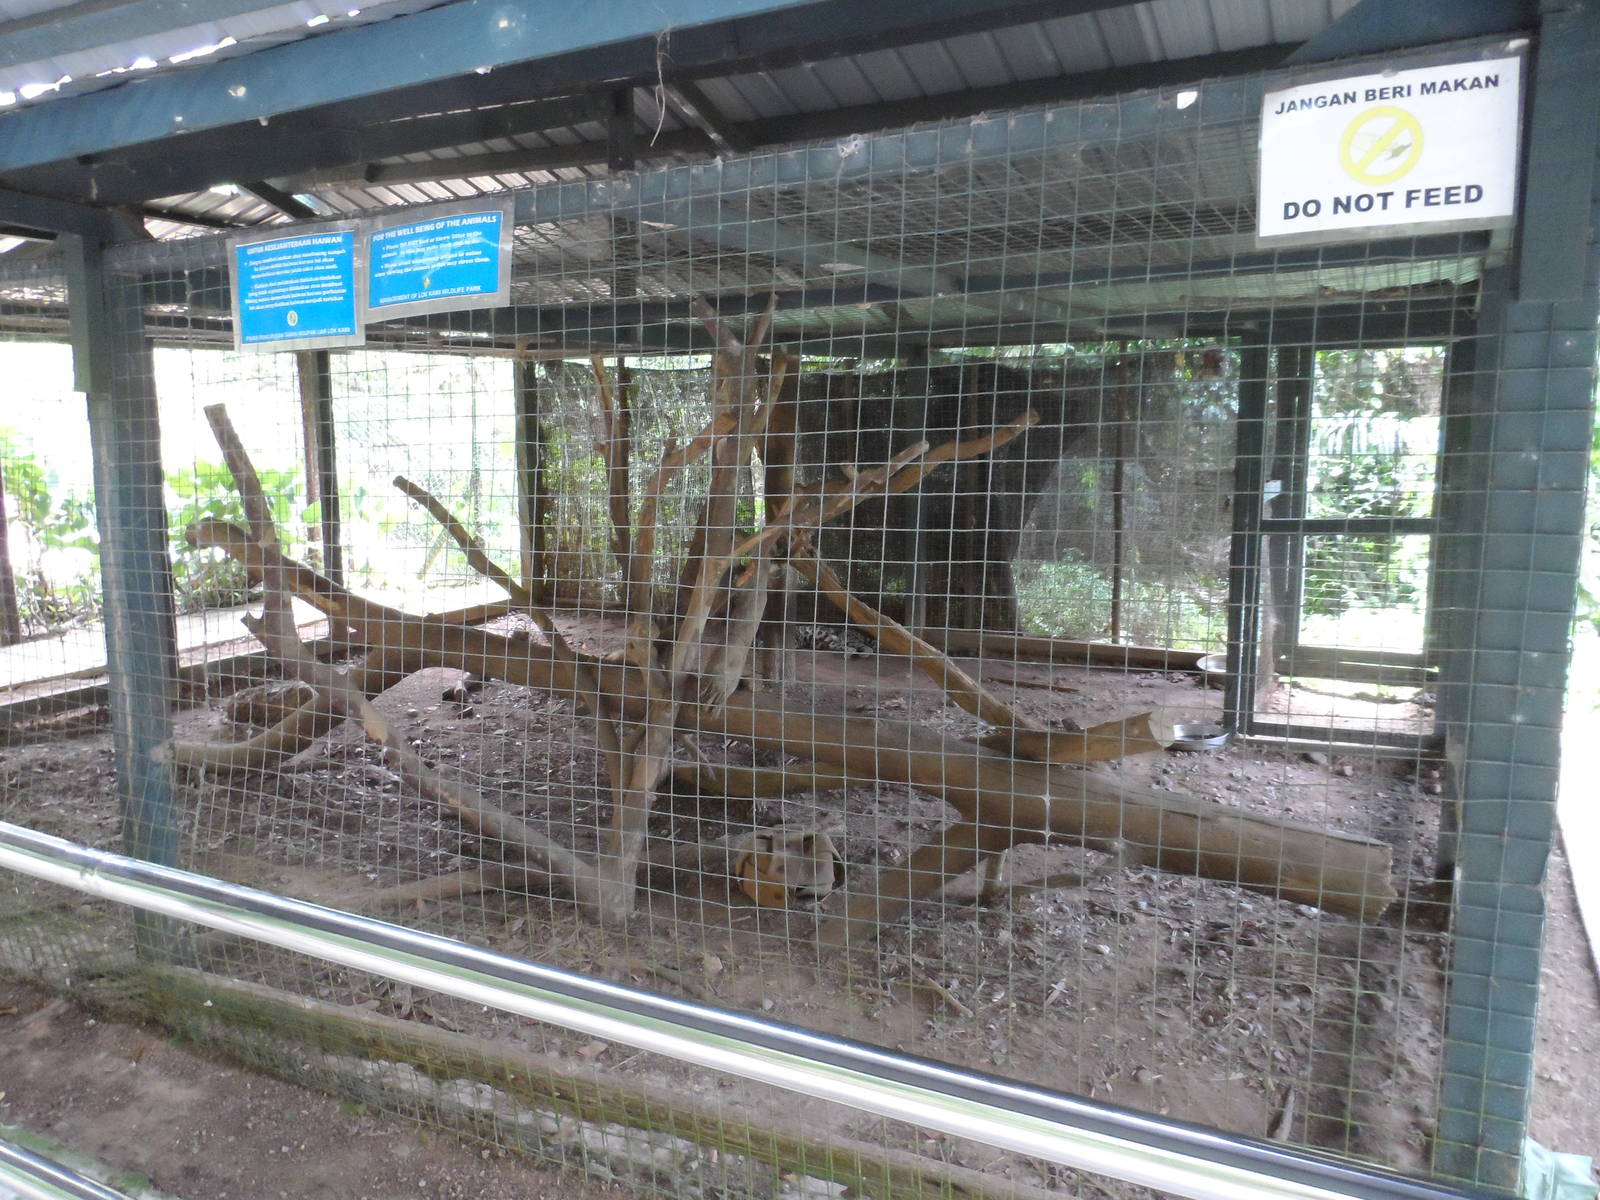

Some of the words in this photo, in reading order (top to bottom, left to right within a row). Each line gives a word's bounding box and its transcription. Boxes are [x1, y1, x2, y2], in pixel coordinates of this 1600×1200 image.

[1275, 91, 1357, 115] JANGAN
[1364, 85, 1412, 103] BERI
[1420, 74, 1500, 96] MAKAN
[1283, 199, 1322, 220] DO
[1332, 191, 1395, 215] NOT
[1405, 184, 1484, 209] FEED
[312, 236, 342, 245] HAIWAN
[397, 227, 415, 237] WELL
[415, 224, 435, 234] BEING
[436, 221, 445, 230] OF
[446, 219, 460, 228] THE
[461, 216, 496, 225] ANIMALS
